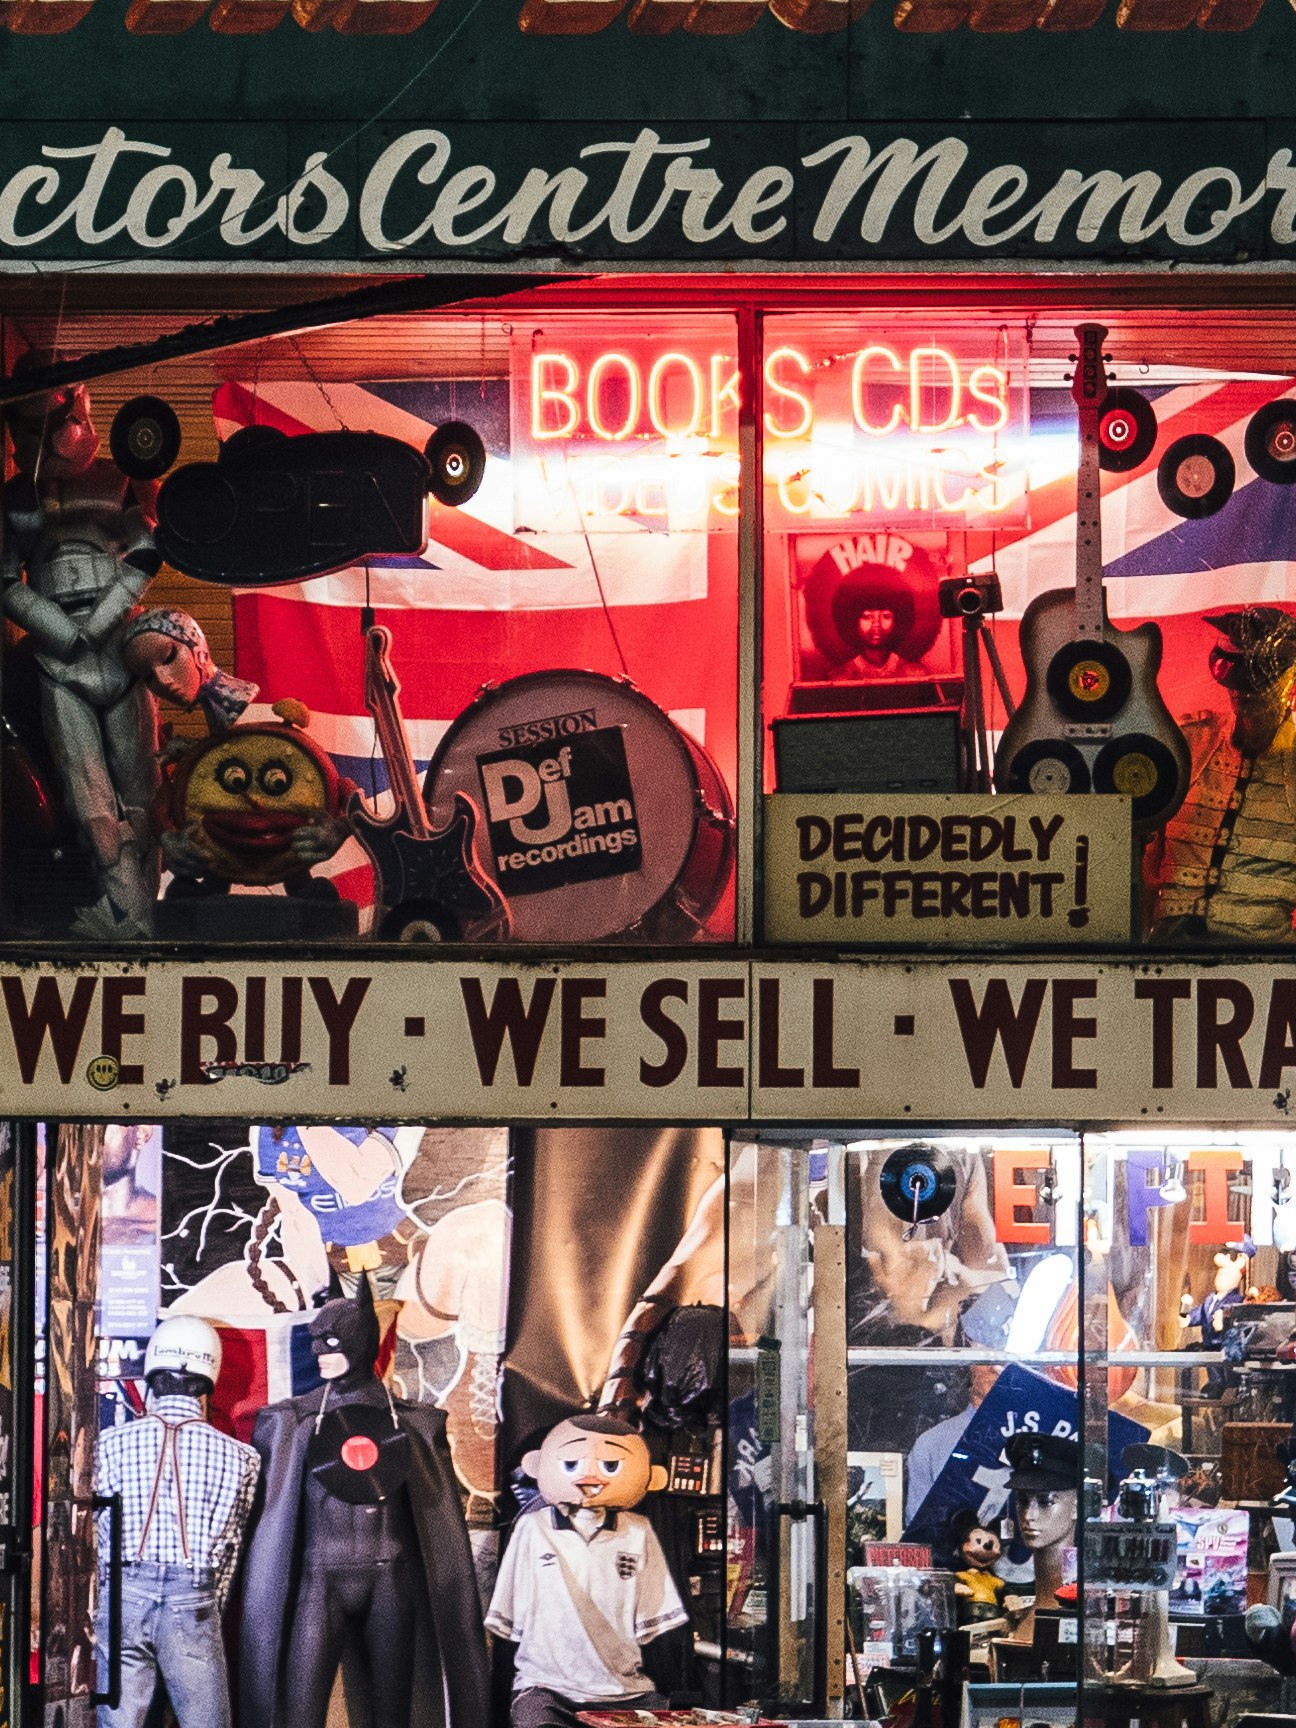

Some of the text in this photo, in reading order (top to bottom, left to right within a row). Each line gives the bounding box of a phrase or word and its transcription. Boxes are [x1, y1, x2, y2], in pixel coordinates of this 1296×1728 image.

[359, 127, 787, 253] Centre
[530, 346, 1009, 440] BOOKS CDs
[830, 534, 914, 576] HAIR
[498, 710, 598, 748] SESSION
[482, 746, 573, 823] Def
[498, 828, 638, 872] recordings
[796, 813, 1065, 863] DECIDEDLY
[0, 976, 146, 1085] WE
[182, 976, 372, 1085] BUY
[460, 977, 607, 1088] WE
[640, 978, 860, 1088] SELL
[948, 978, 1098, 1089] WE
